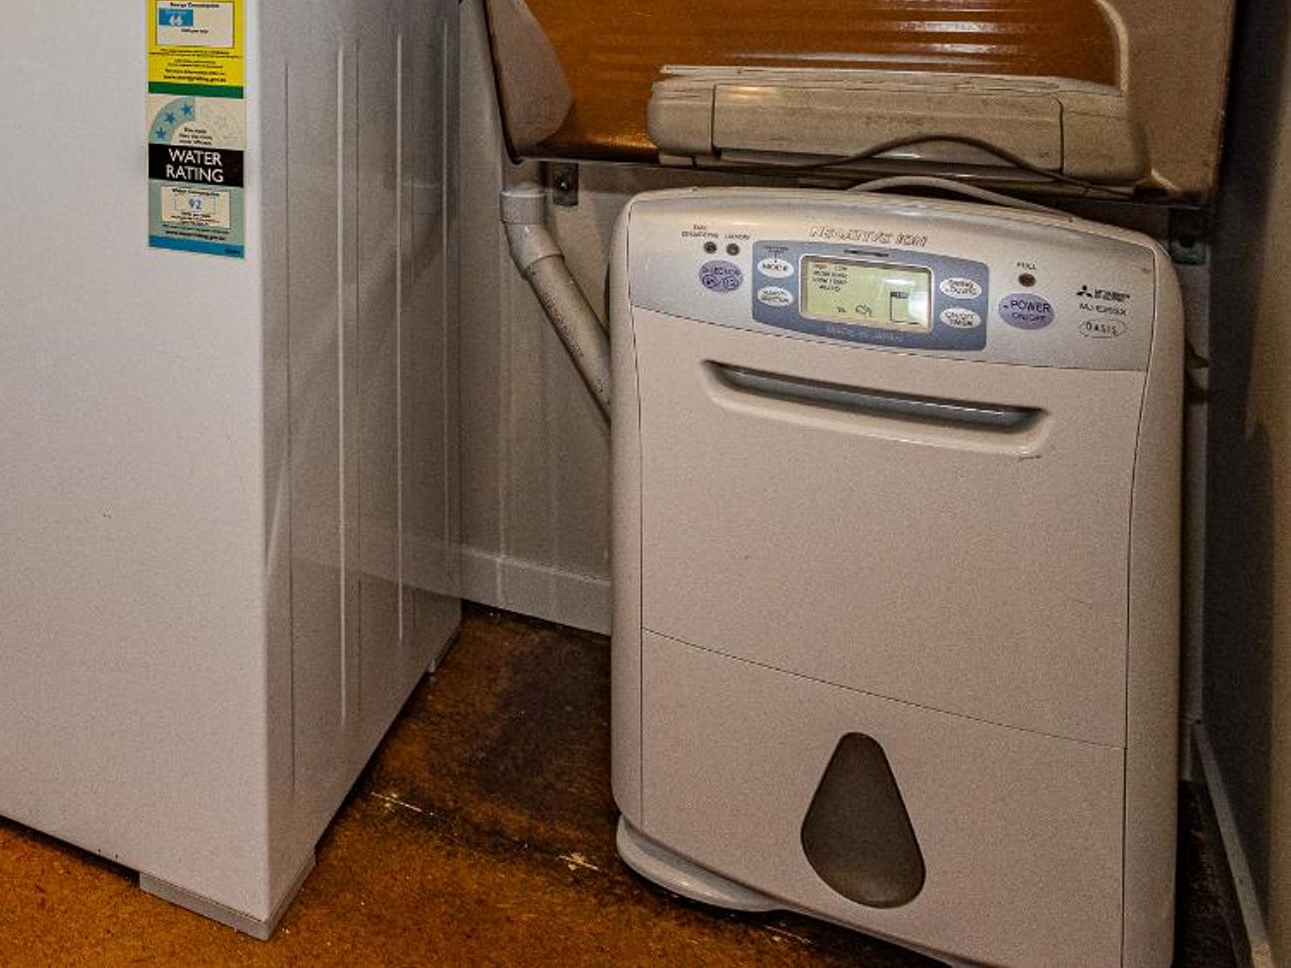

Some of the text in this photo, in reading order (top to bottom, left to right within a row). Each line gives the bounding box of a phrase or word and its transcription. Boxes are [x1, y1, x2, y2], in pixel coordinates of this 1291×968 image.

[168, 148, 223, 166] WATER
[166, 165, 224, 183] RATING
[1010, 299, 1051, 313] POWER
